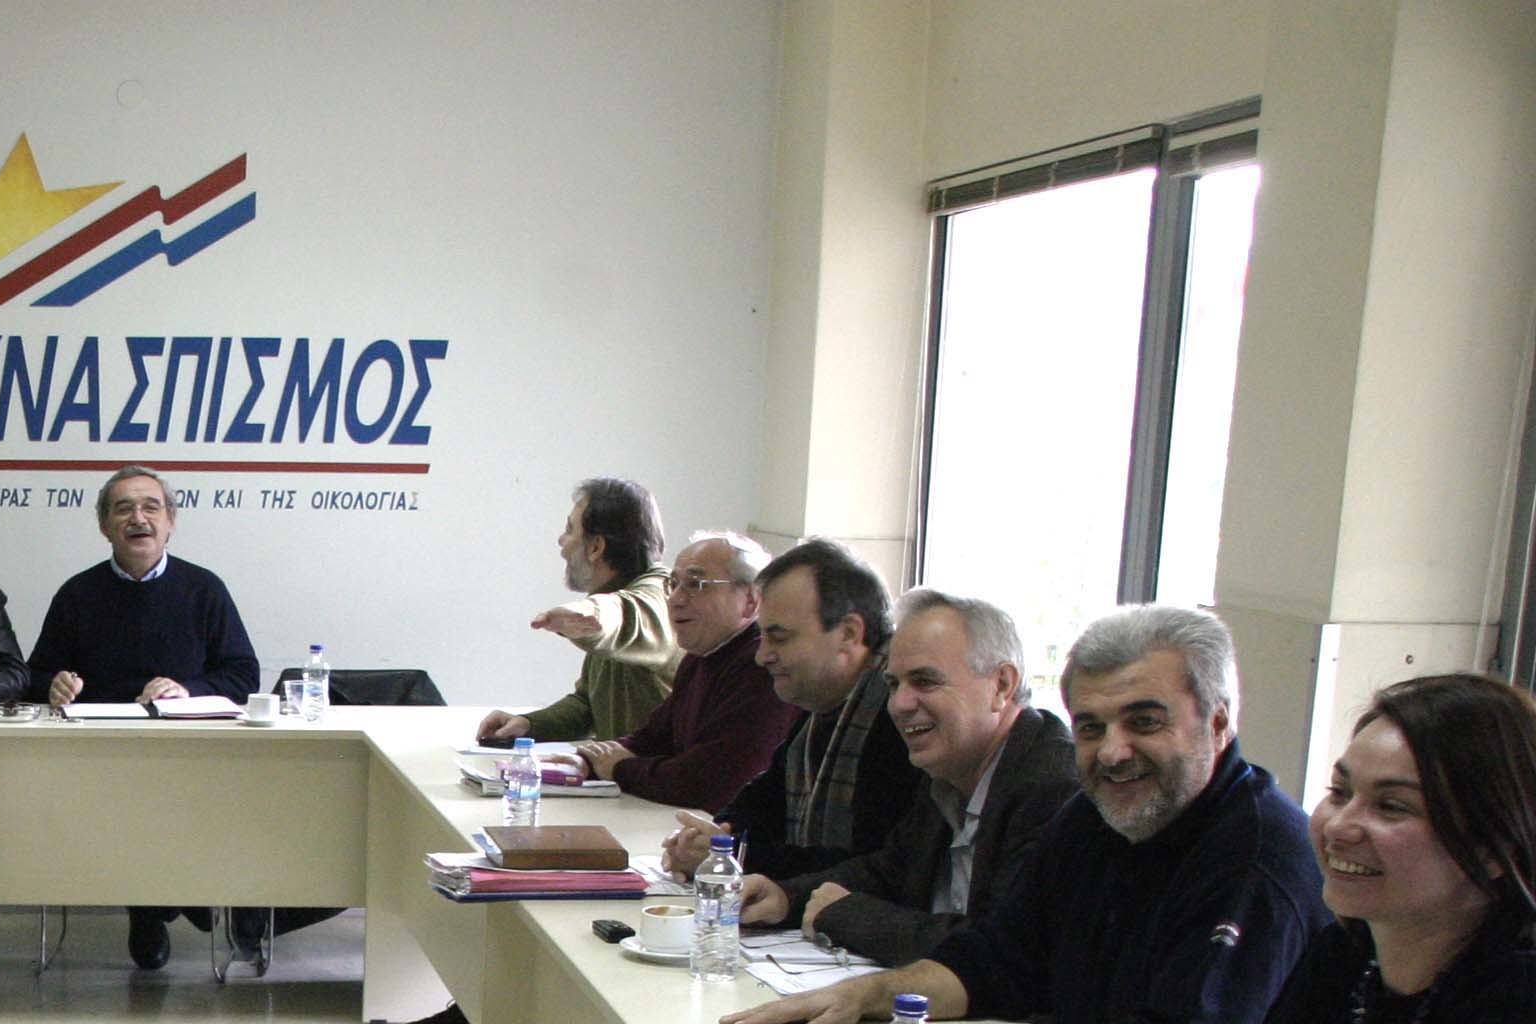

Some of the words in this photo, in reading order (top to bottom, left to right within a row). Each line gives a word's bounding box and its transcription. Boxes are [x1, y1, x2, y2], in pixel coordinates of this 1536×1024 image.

[46, 488, 84, 508] ΤΩΝ
[213, 489, 243, 509] ΚΑΙ
[260, 489, 297, 510] ΤΗΣ
[311, 490, 419, 511] ΟΙΚΟΛΟΓΙΑΣ
